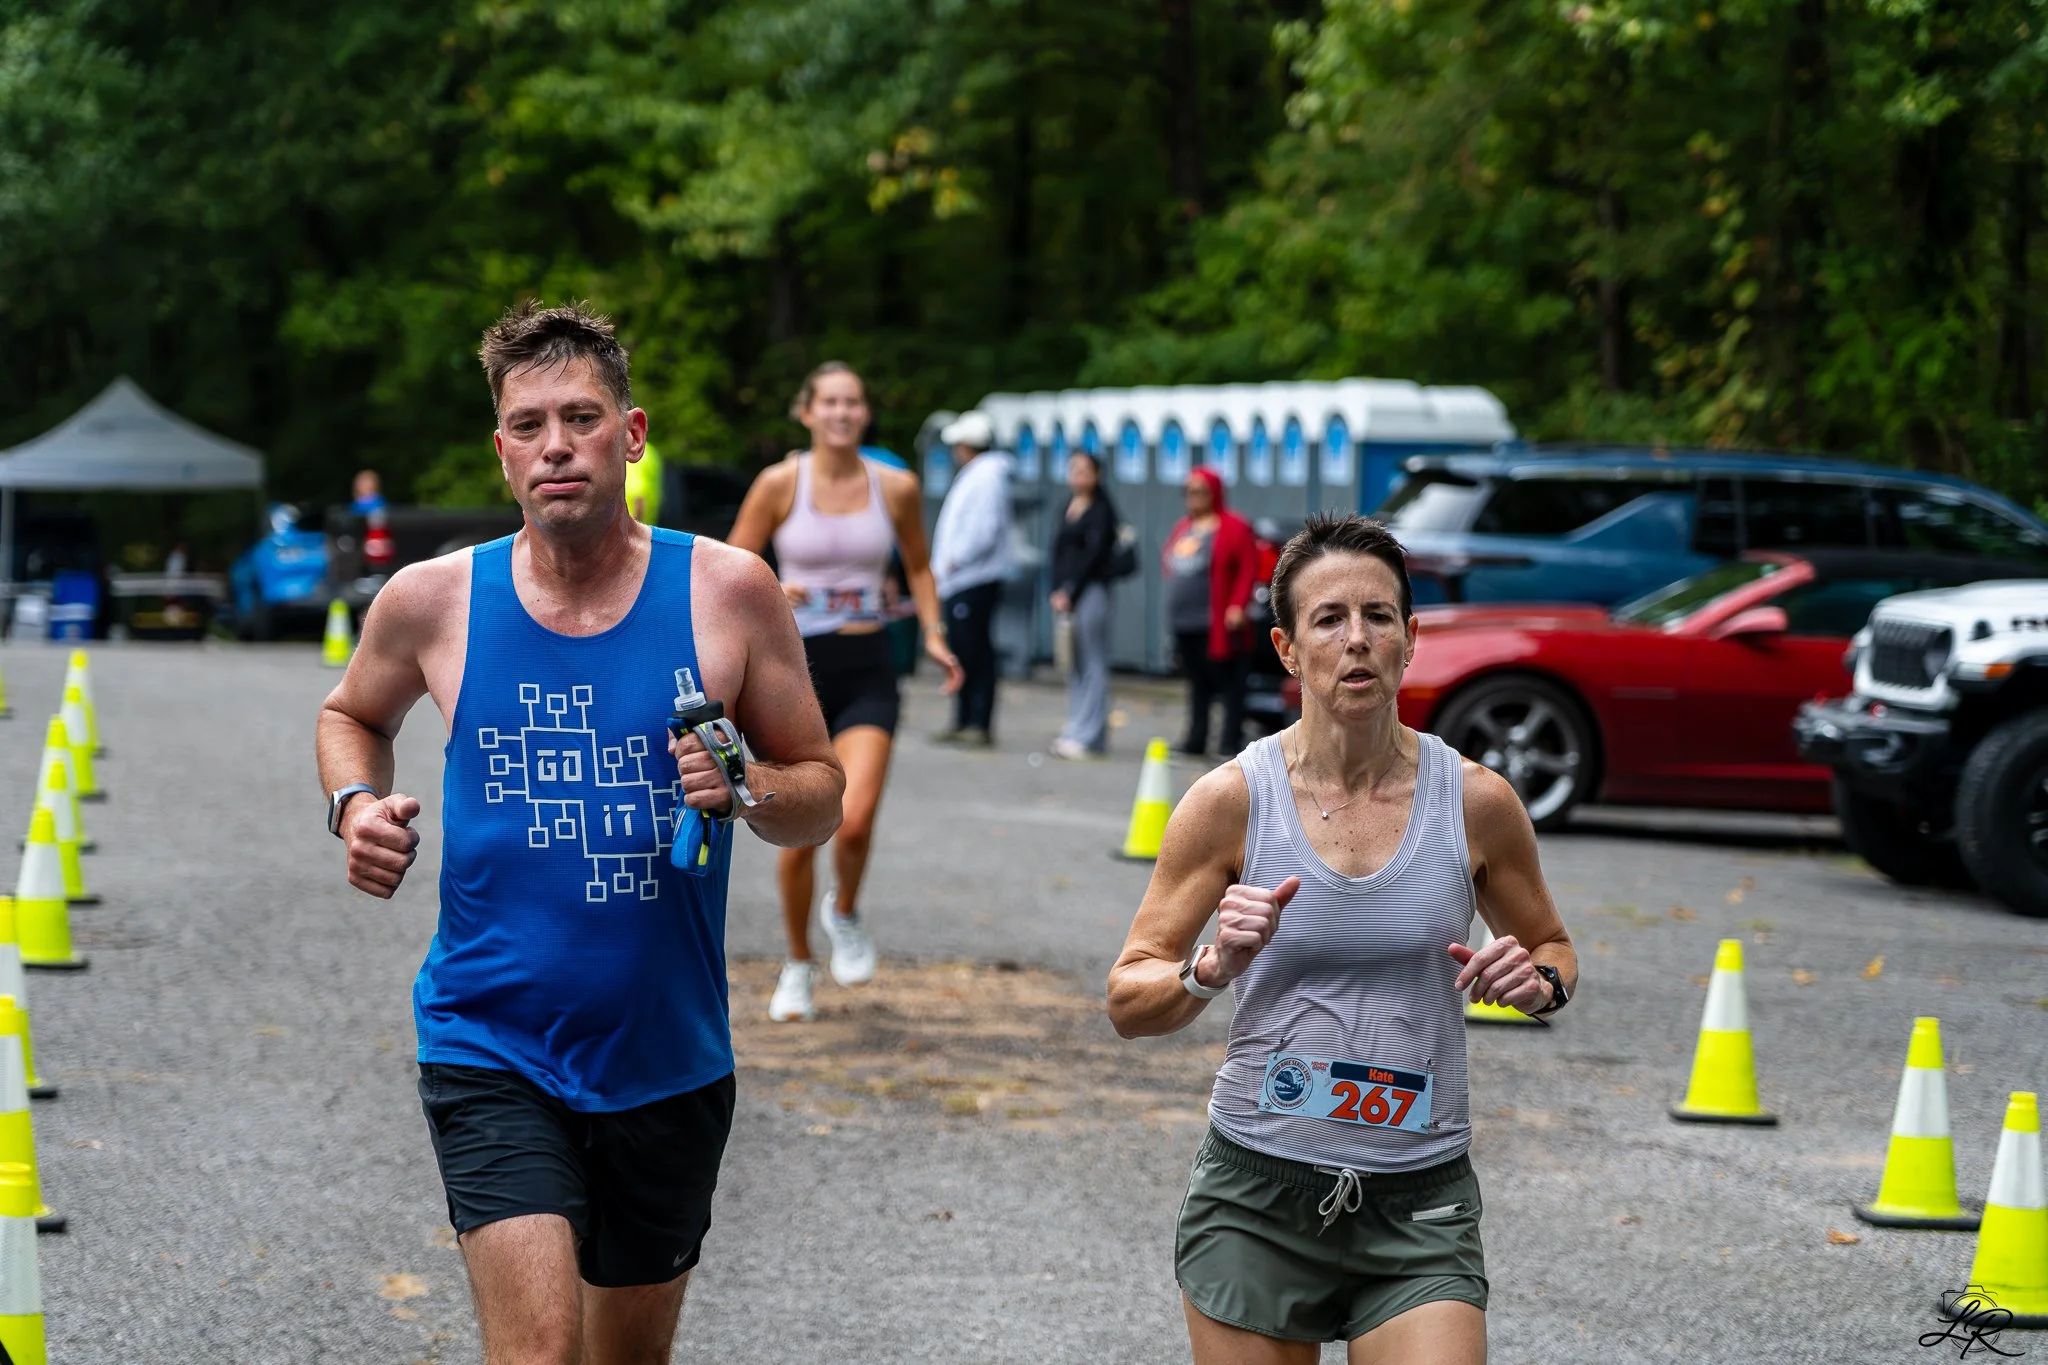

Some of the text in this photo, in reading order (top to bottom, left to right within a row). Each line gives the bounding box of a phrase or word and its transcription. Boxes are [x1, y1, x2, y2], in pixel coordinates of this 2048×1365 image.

[537, 750, 582, 781] GO
[1368, 1068, 1394, 1083] Kate
[1327, 1080, 1418, 1127] 267
